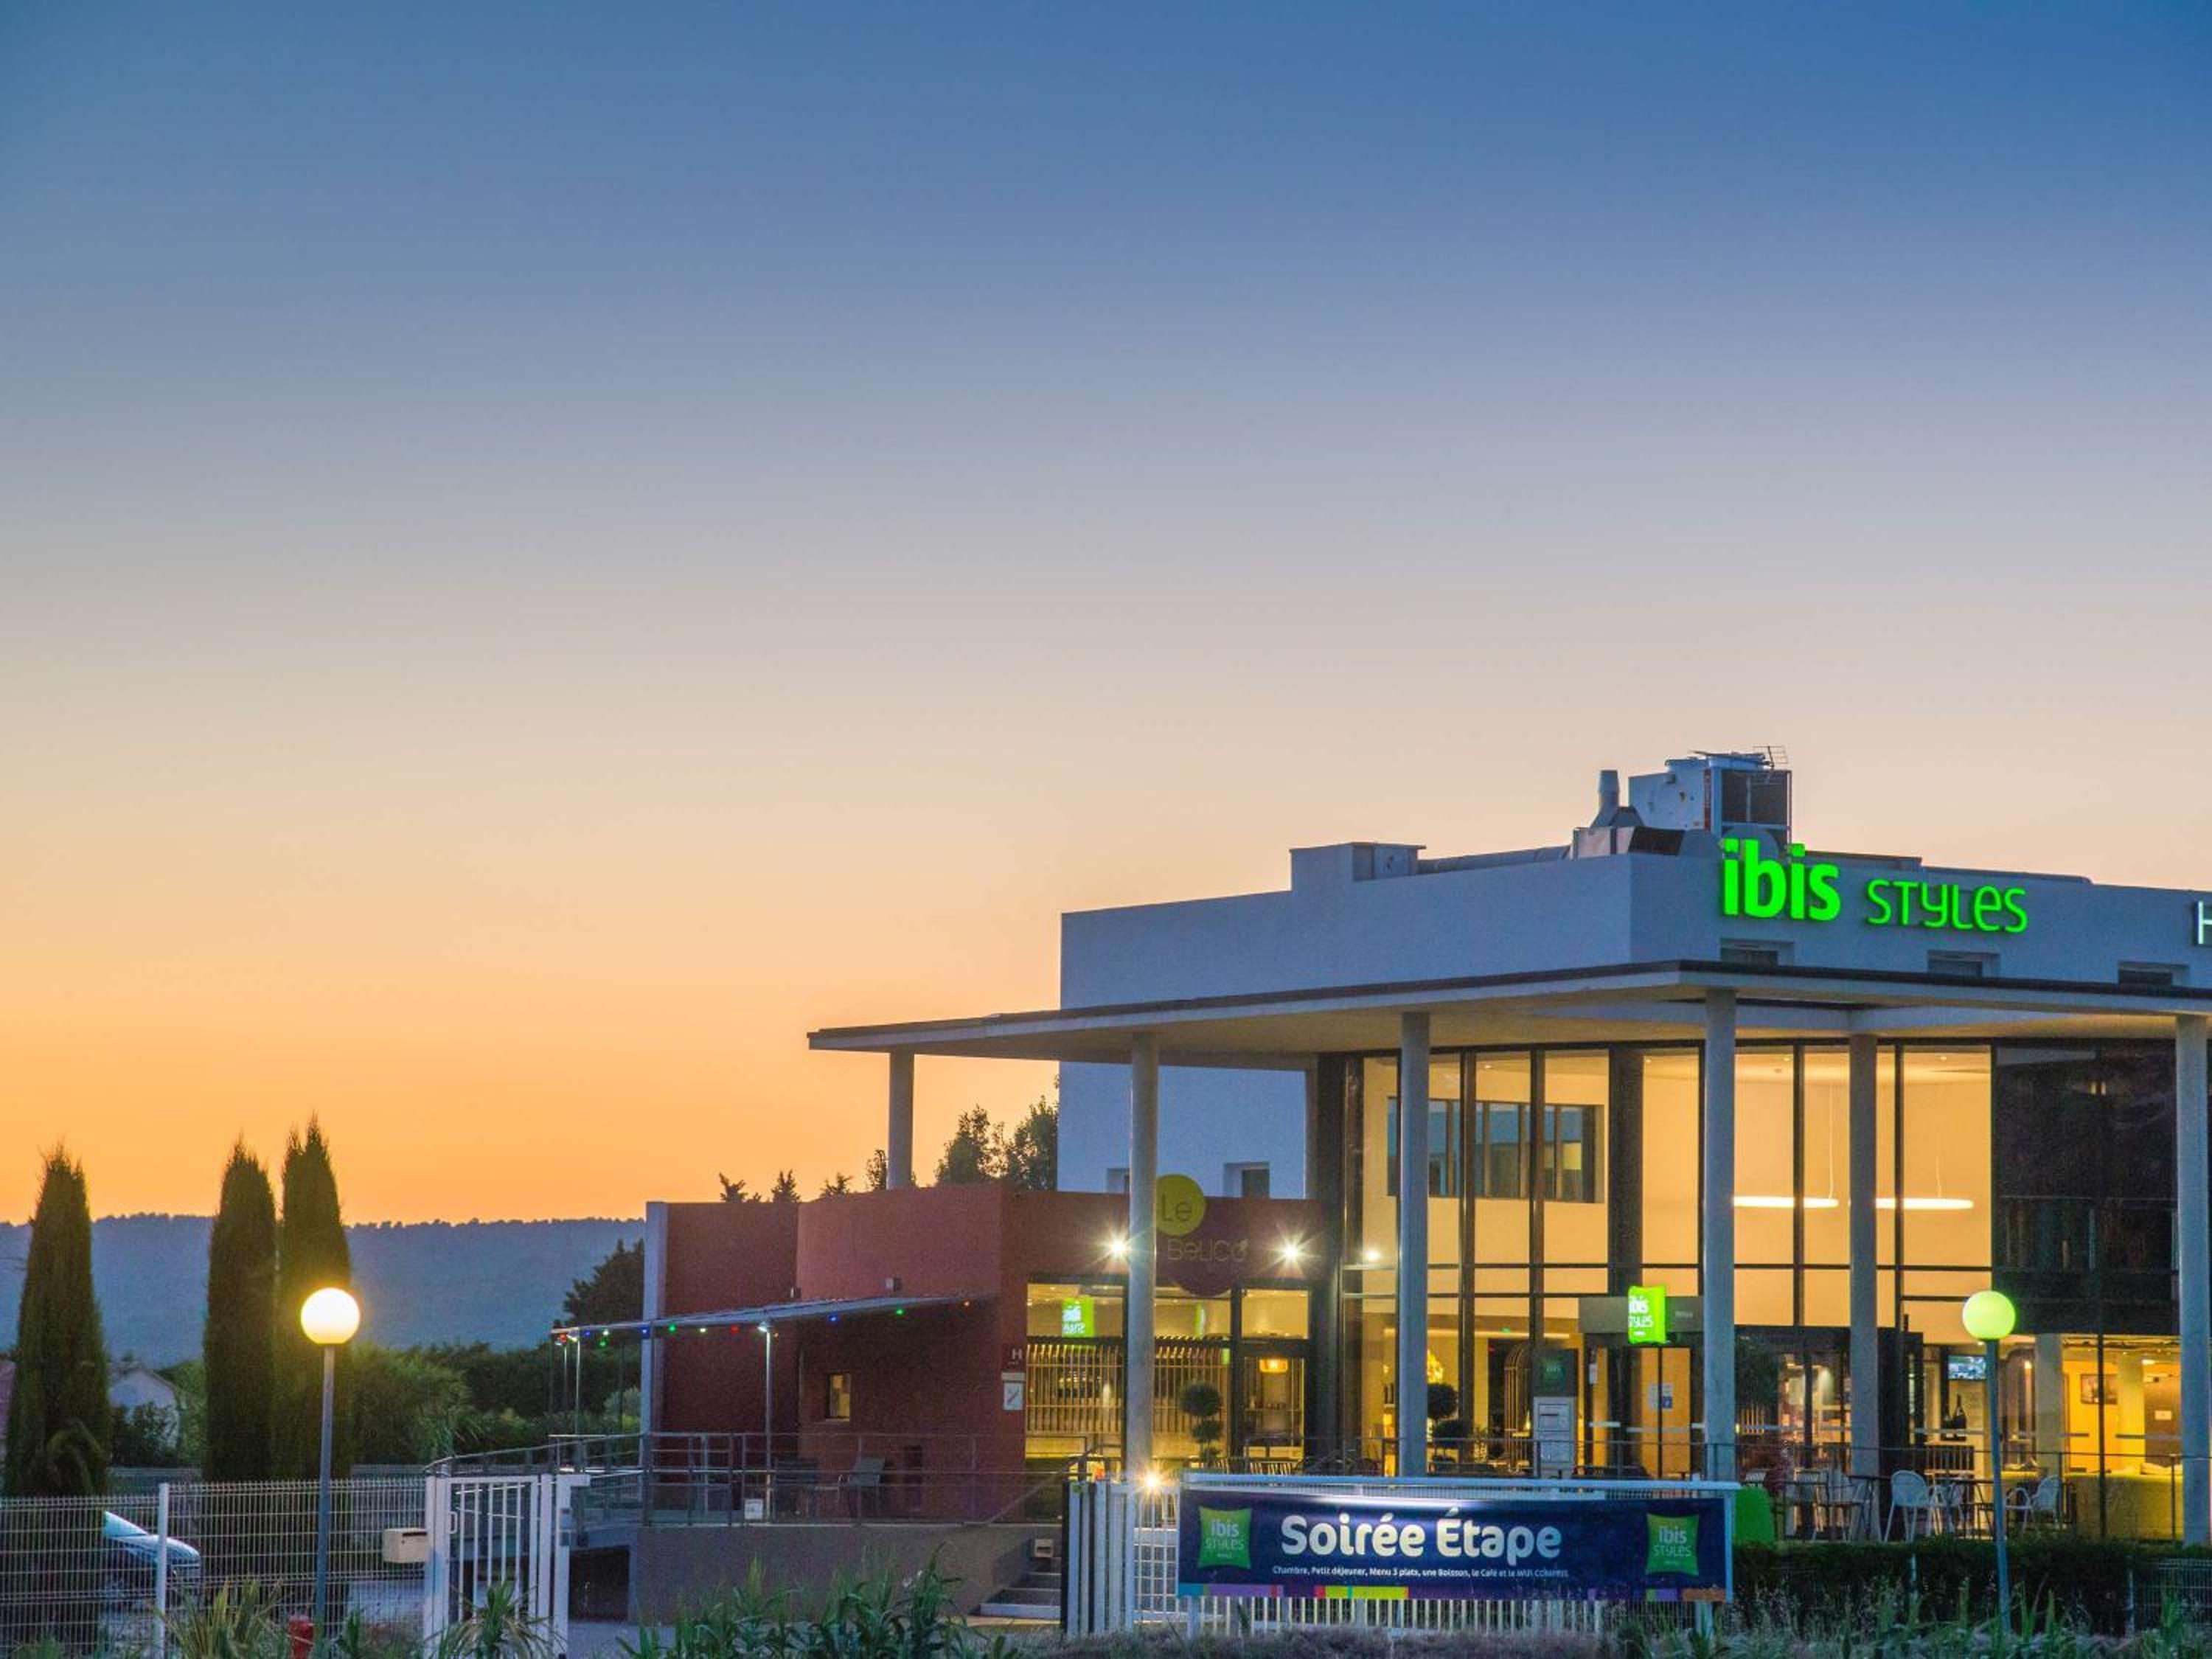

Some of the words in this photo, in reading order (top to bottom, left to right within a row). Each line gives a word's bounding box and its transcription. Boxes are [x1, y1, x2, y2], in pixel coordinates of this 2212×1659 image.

[1721, 838, 1840, 921] ibis
[1161, 1194, 1192, 1222] Le
[1210, 1518, 1240, 1538] ibis
[1281, 1512, 1425, 1557] Soirée
[1436, 1506, 1562, 1566] Étape
[1658, 1525, 1688, 1545] ibis
[1370, 1567, 1392, 1576] Menu
[1399, 1568, 1422, 1578] plats,
[1481, 1568, 1498, 1577] Café
